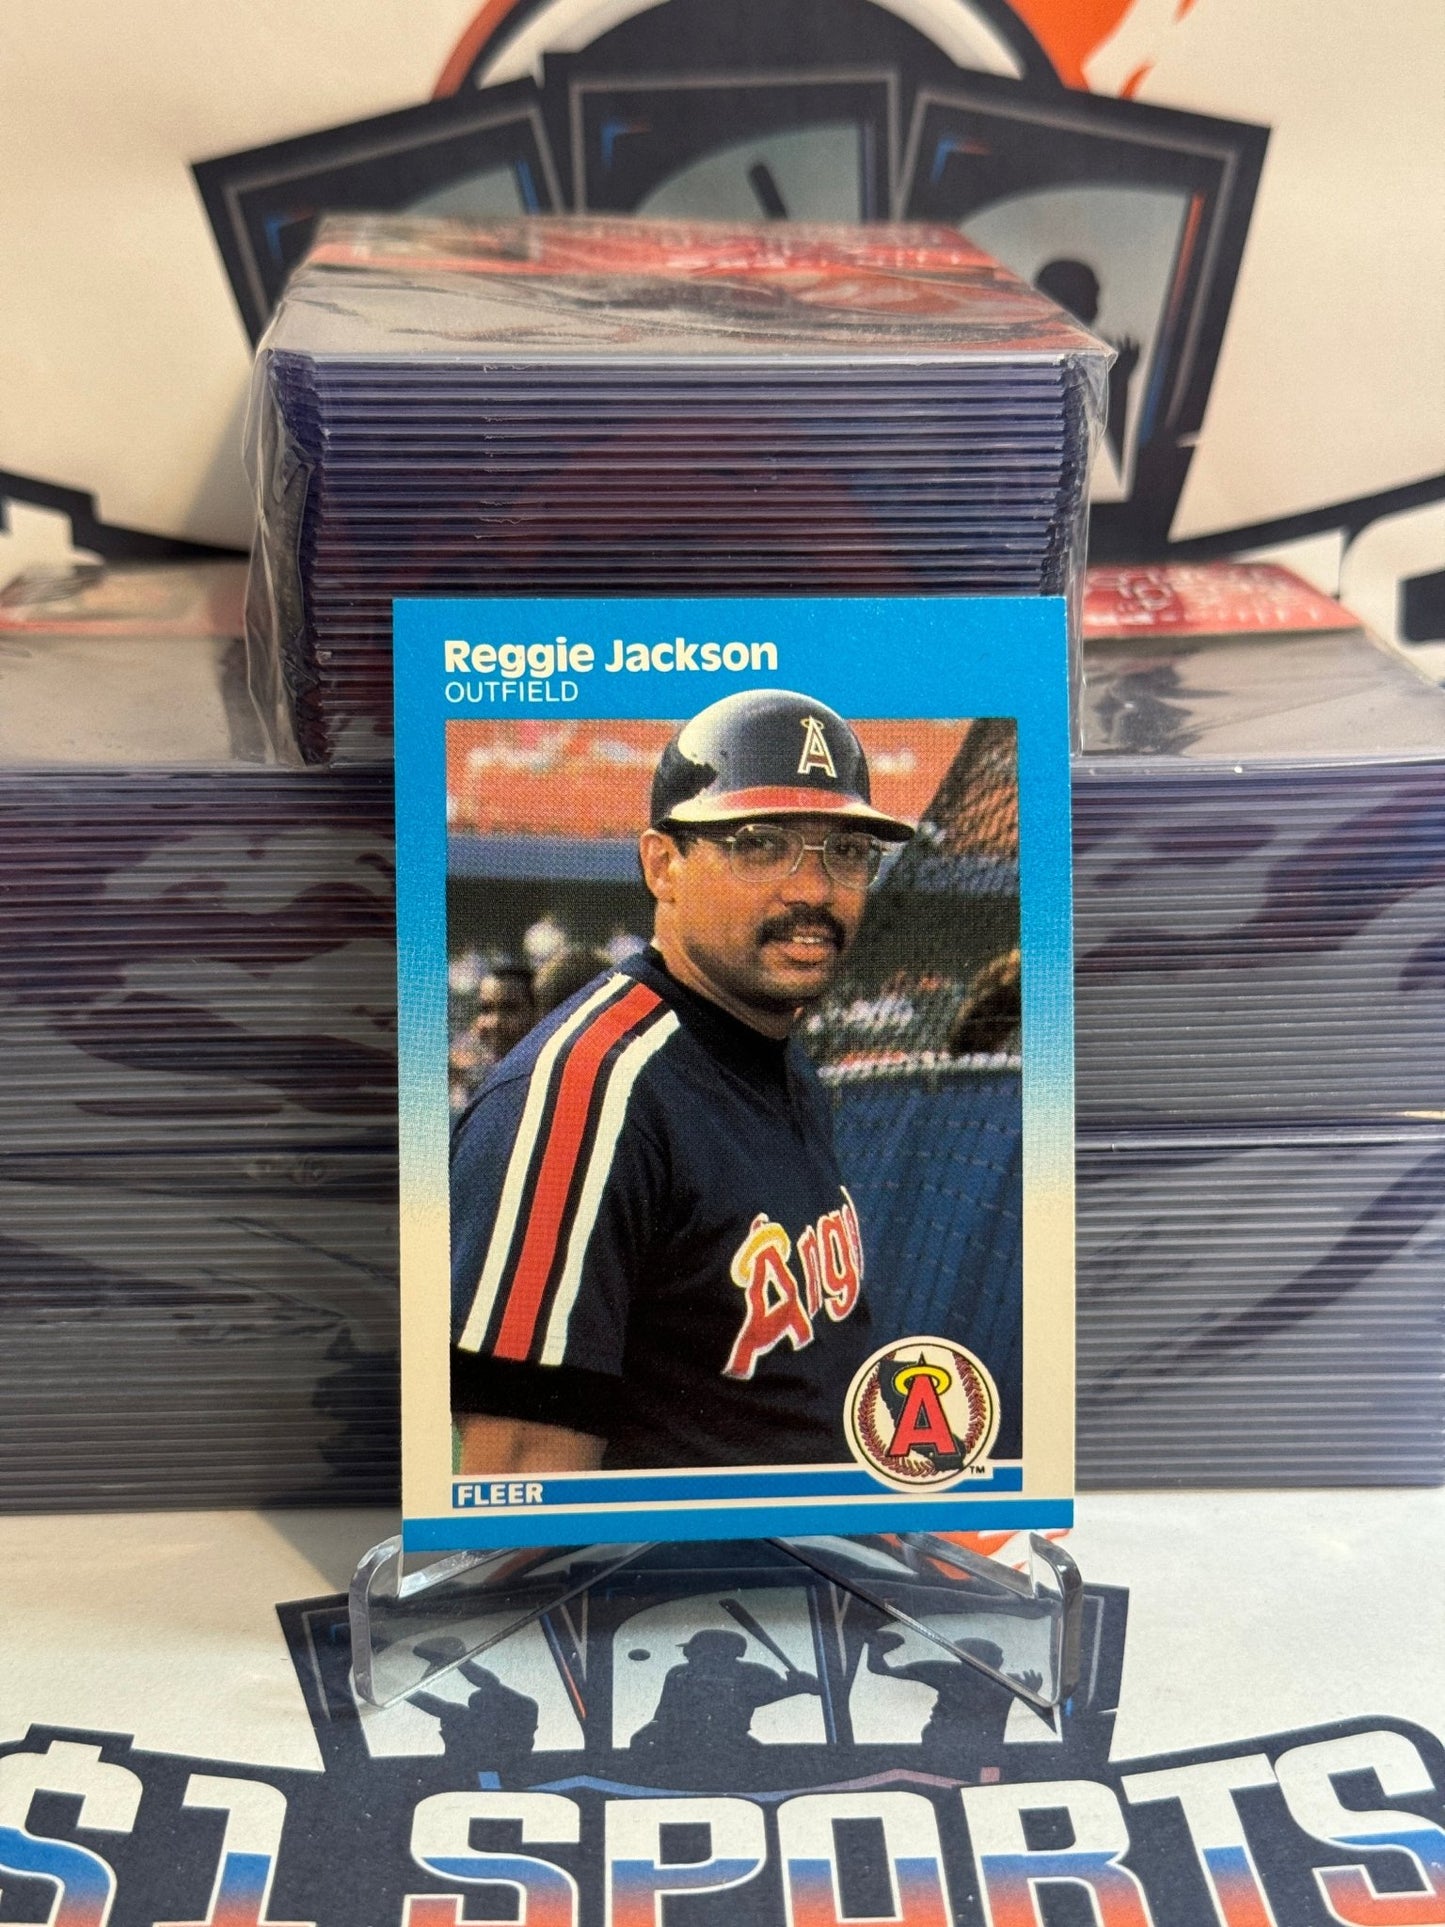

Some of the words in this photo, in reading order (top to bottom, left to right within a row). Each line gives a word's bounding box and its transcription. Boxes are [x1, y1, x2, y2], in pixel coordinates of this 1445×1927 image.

[444, 636, 595, 679] Reggie
[604, 637, 779, 672] Jackson
[444, 680, 579, 704] OUTFIELD
[969, 1465, 986, 1475] TM
[457, 1482, 544, 1507] FLEER
[402, 1730, 1445, 1927] SPORTS
